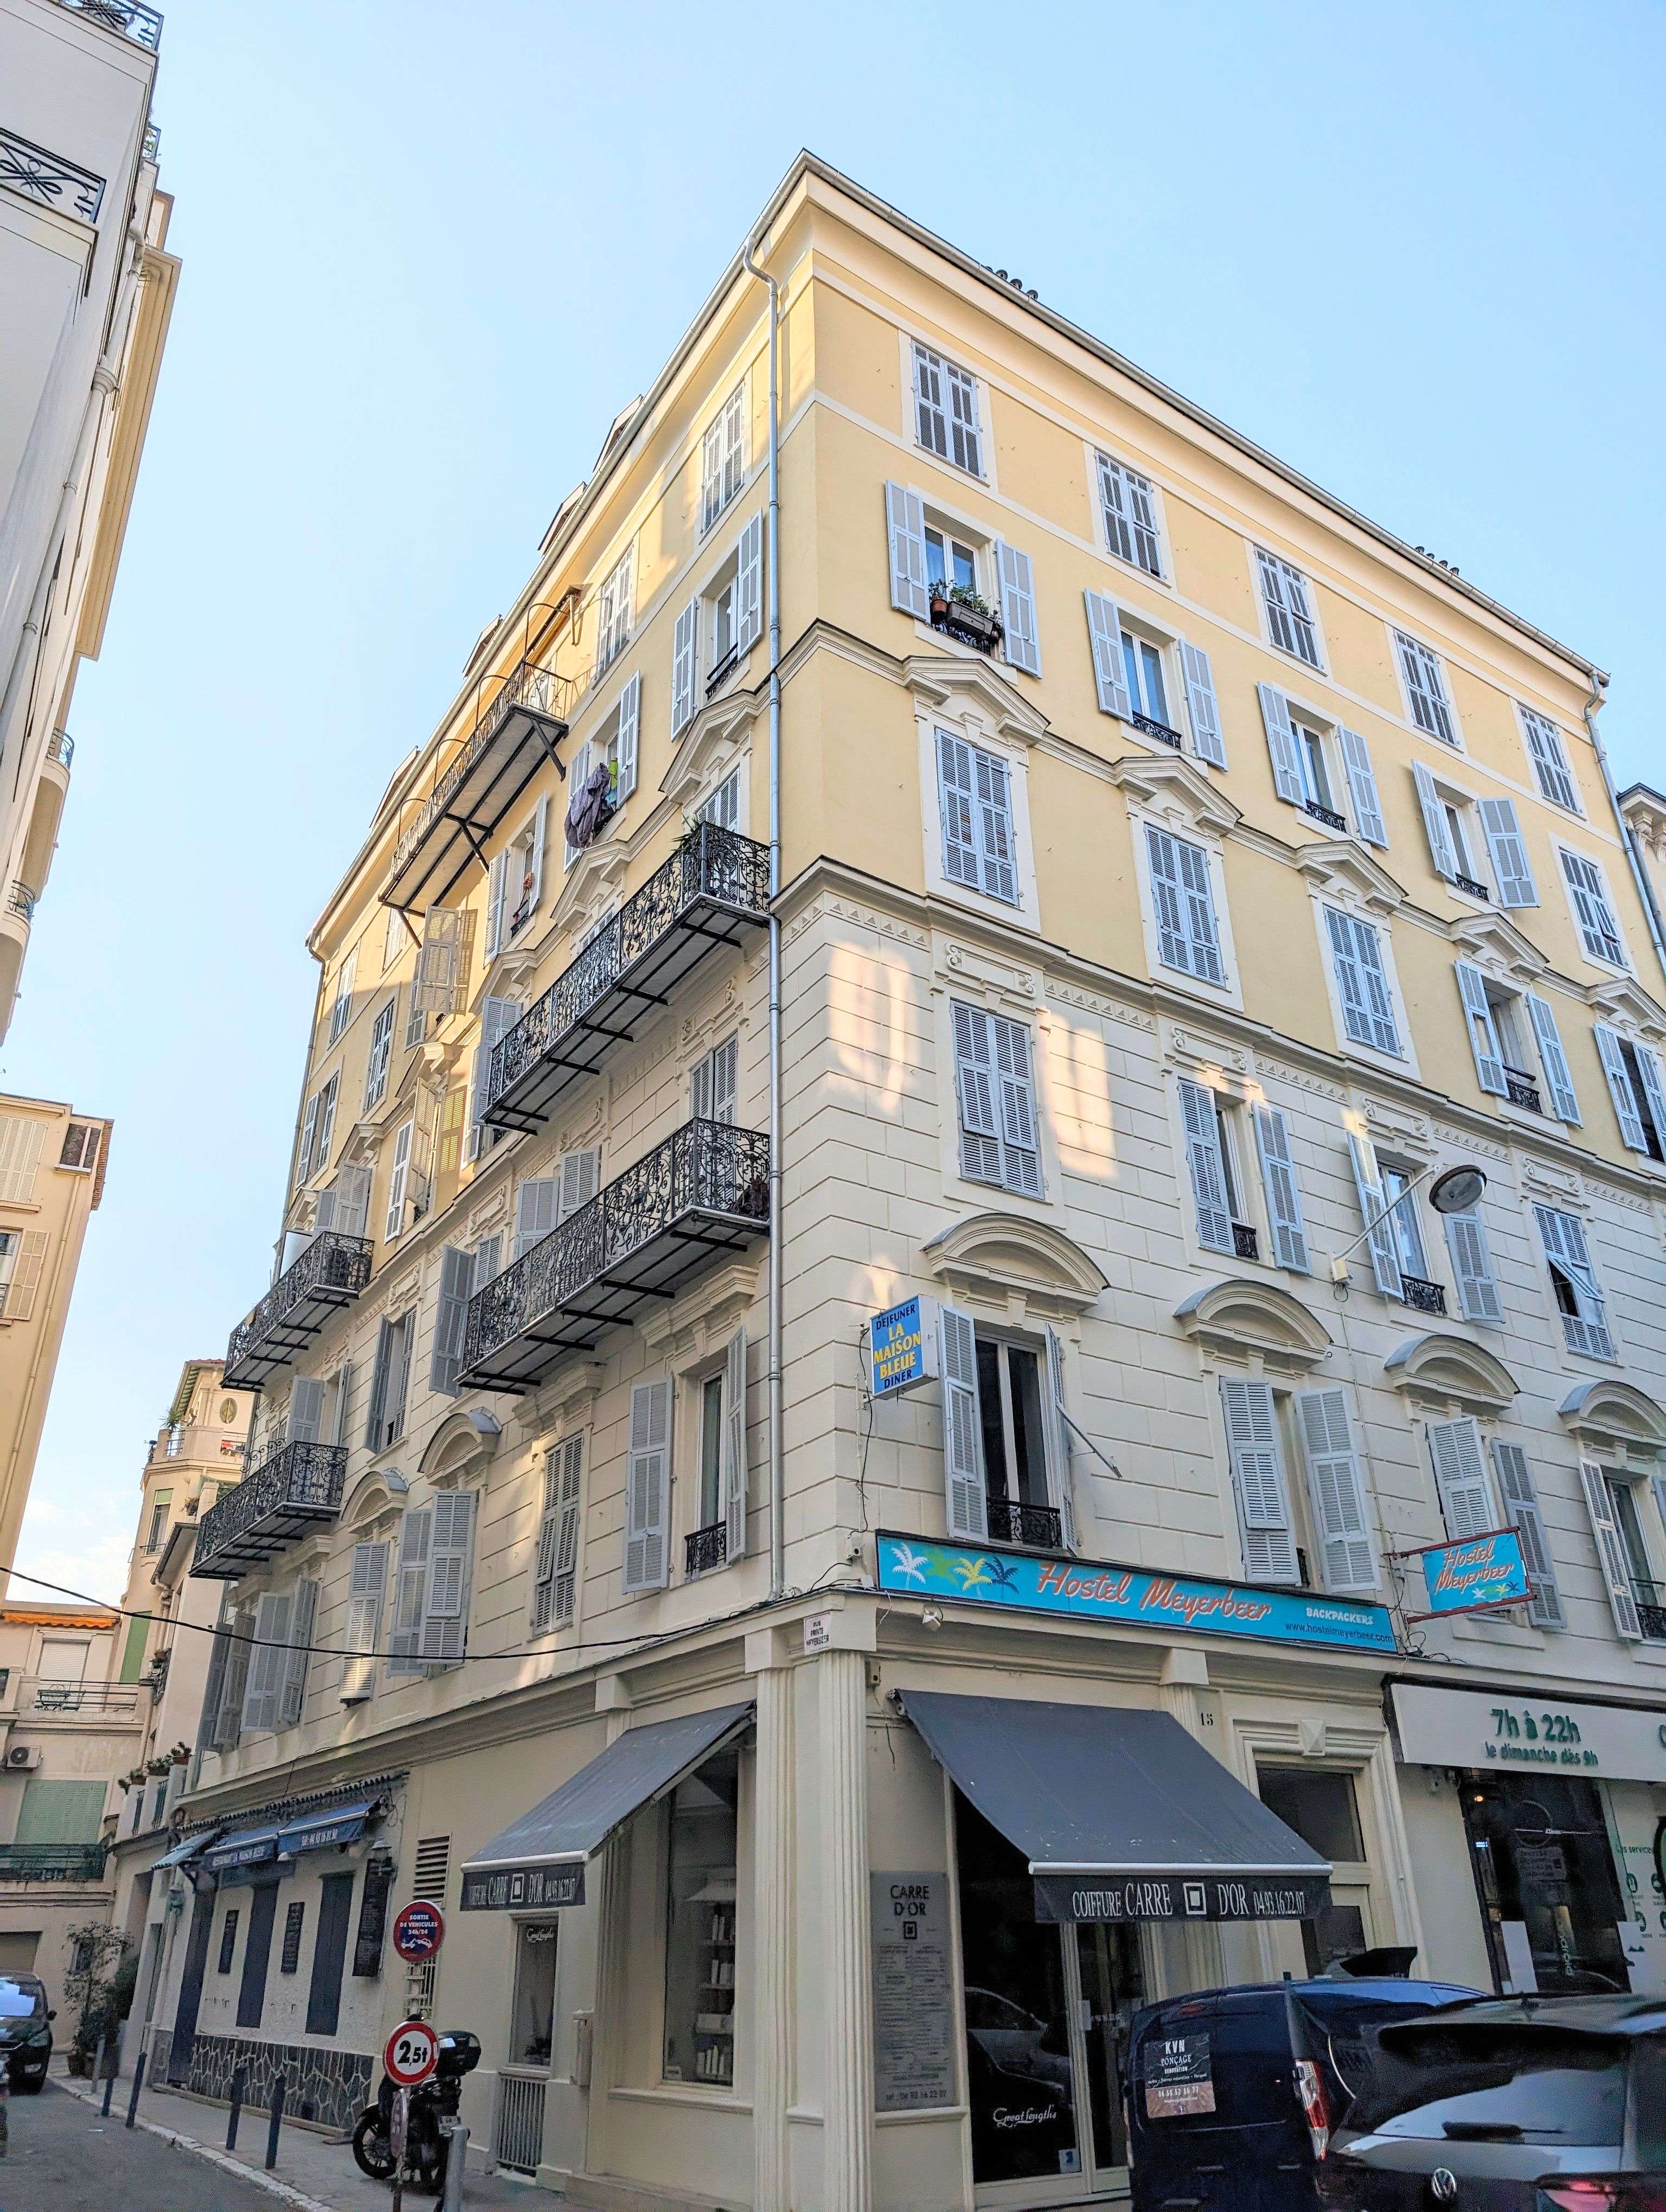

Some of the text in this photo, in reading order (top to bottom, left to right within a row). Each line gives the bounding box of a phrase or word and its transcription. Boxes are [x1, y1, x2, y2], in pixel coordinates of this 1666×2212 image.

[888, 1323, 905, 1341] LA
[873, 1331, 921, 1365] MAISON
[879, 1351, 916, 1380] BLEUE
[884, 1369, 912, 1389] DINER
[1443, 1540, 1495, 1570] Hostel
[1434, 1560, 1514, 1595] Meyerbeer
[1037, 1561, 1272, 1624] Hostel Meyerbeer
[1305, 1606, 1374, 1625] BACKPACKERS
[1201, 1712, 1214, 1726] 15
[1491, 1708, 1581, 1742] 7h à 22h
[1484, 1740, 1497, 1758] le
[1501, 1742, 1558, 1763] dimanche
[890, 1885, 930, 1900] CARRE
[1072, 1882, 1305, 1918] COIFFURE CARRE D'OR 04.93.16.22.07
[398, 2040, 427, 2066] 2,5t
[1165, 2039, 1185, 2055] KVN
[1161, 2054, 1191, 2067] PONÇAGE
[993, 2107, 1024, 2128] Great
